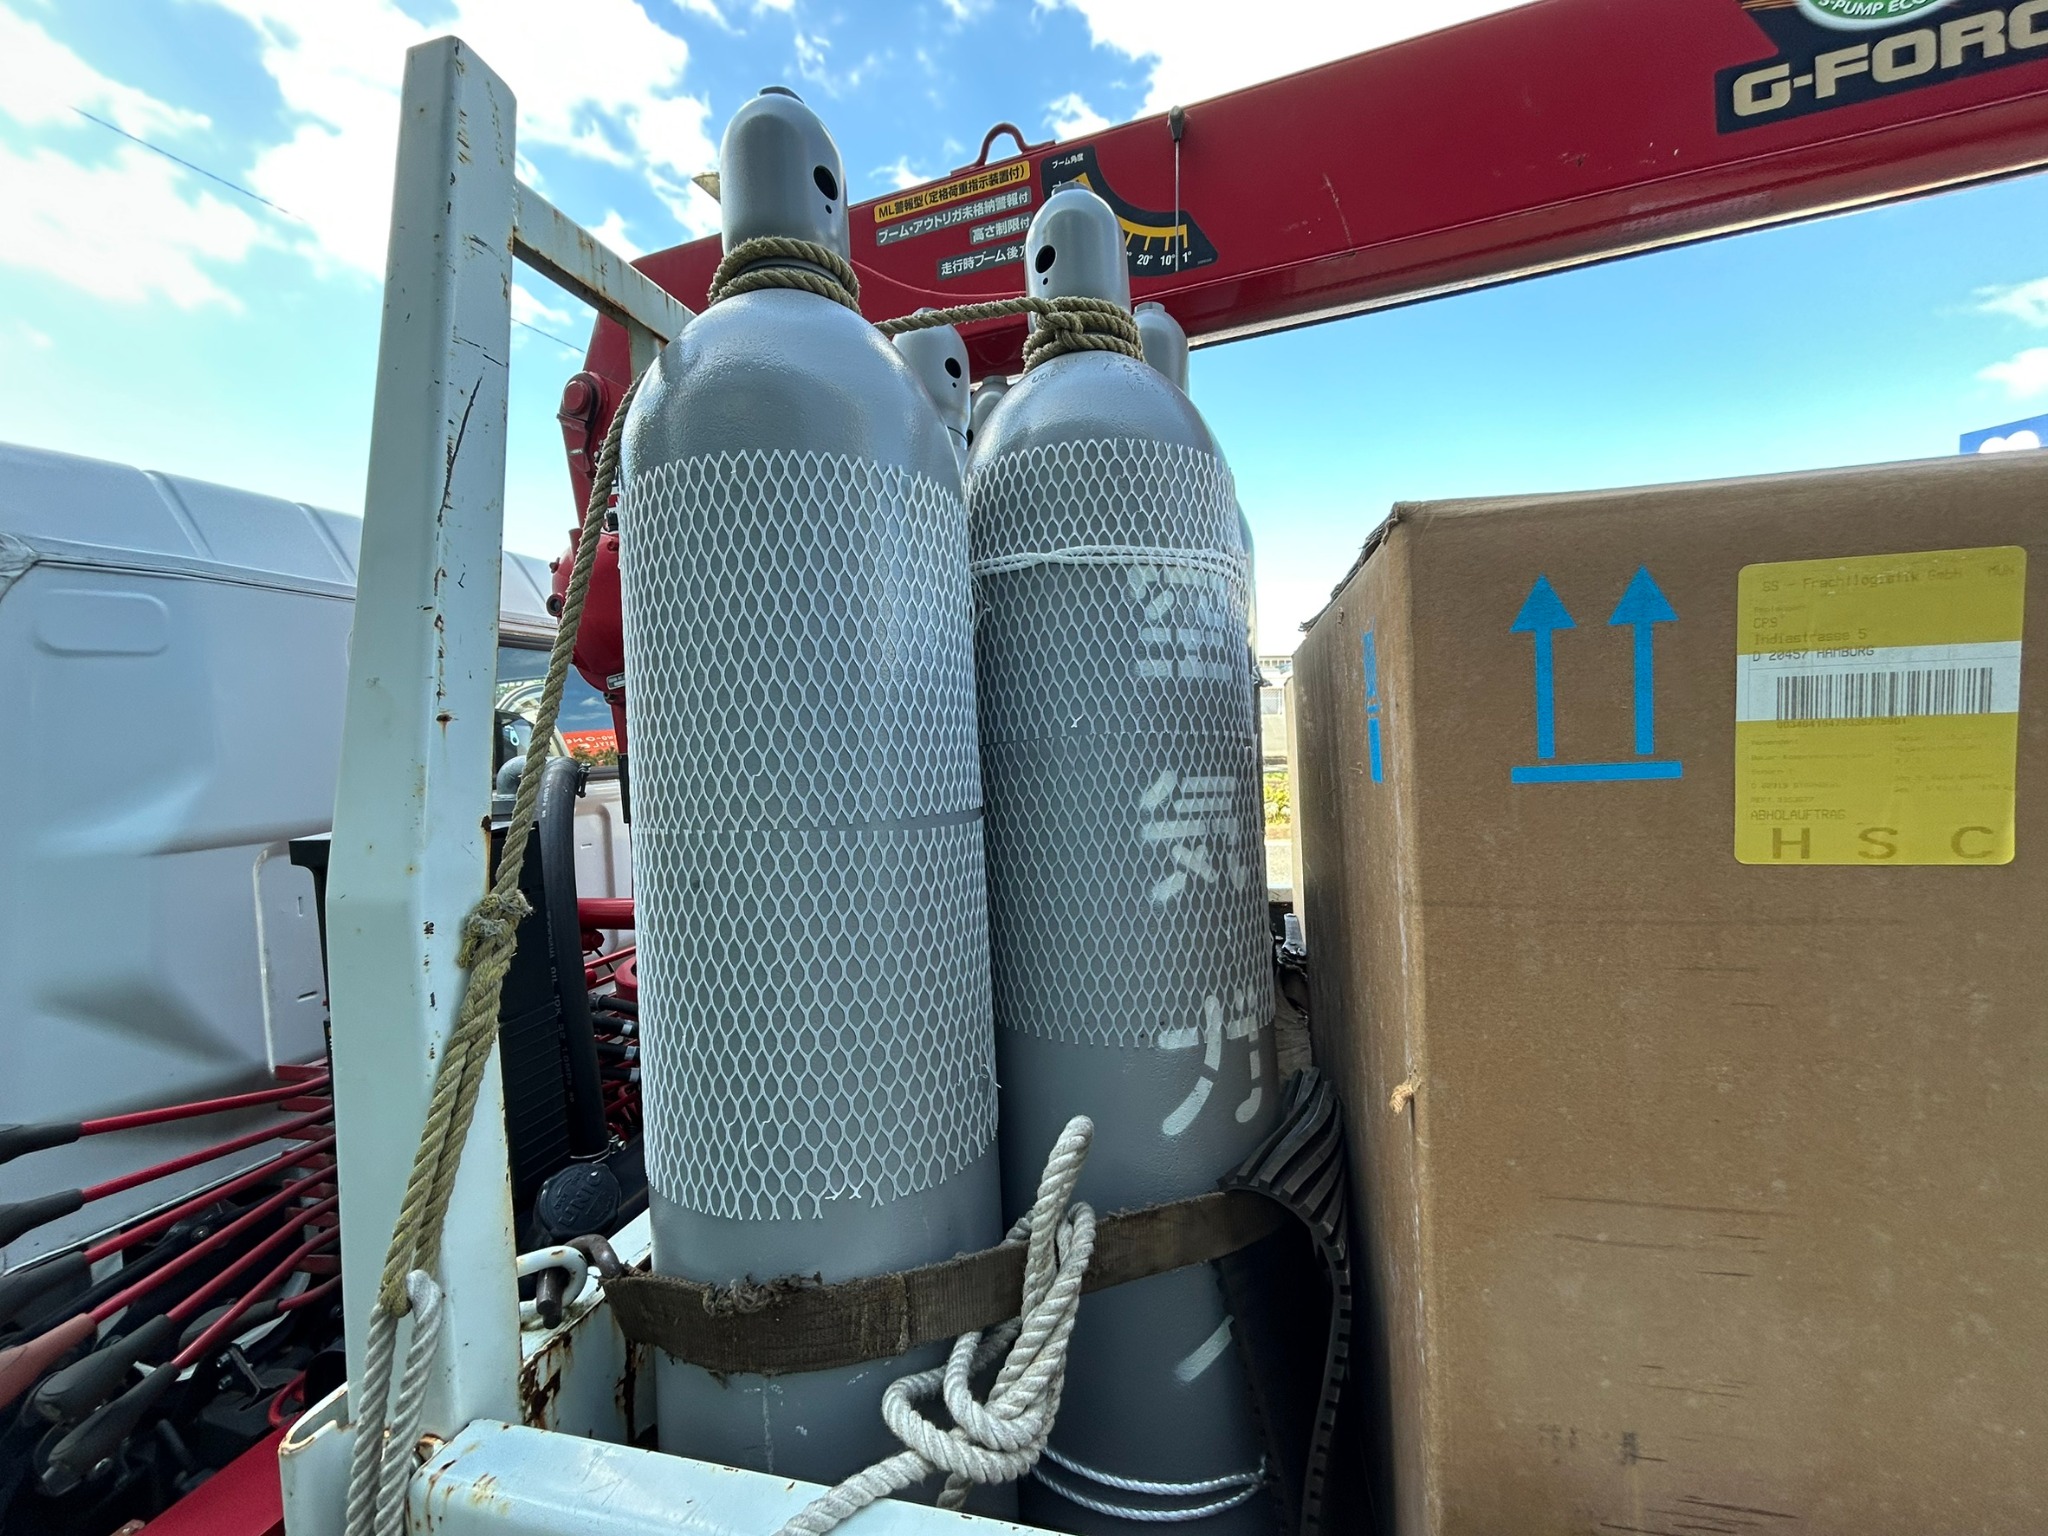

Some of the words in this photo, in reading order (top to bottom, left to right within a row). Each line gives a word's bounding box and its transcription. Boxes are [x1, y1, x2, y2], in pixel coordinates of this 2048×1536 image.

[1051, 153, 1084, 169] ブーム角度
[972, 216, 1030, 243] 高さ制限付
[1858, 628, 1868, 640] 5
[1769, 648, 1809, 661] 20457
[1817, 645, 1875, 659] HAMBURG
[1772, 827, 1811, 860] H
[1857, 826, 1899, 860] S
[1951, 826, 1994, 859] C
